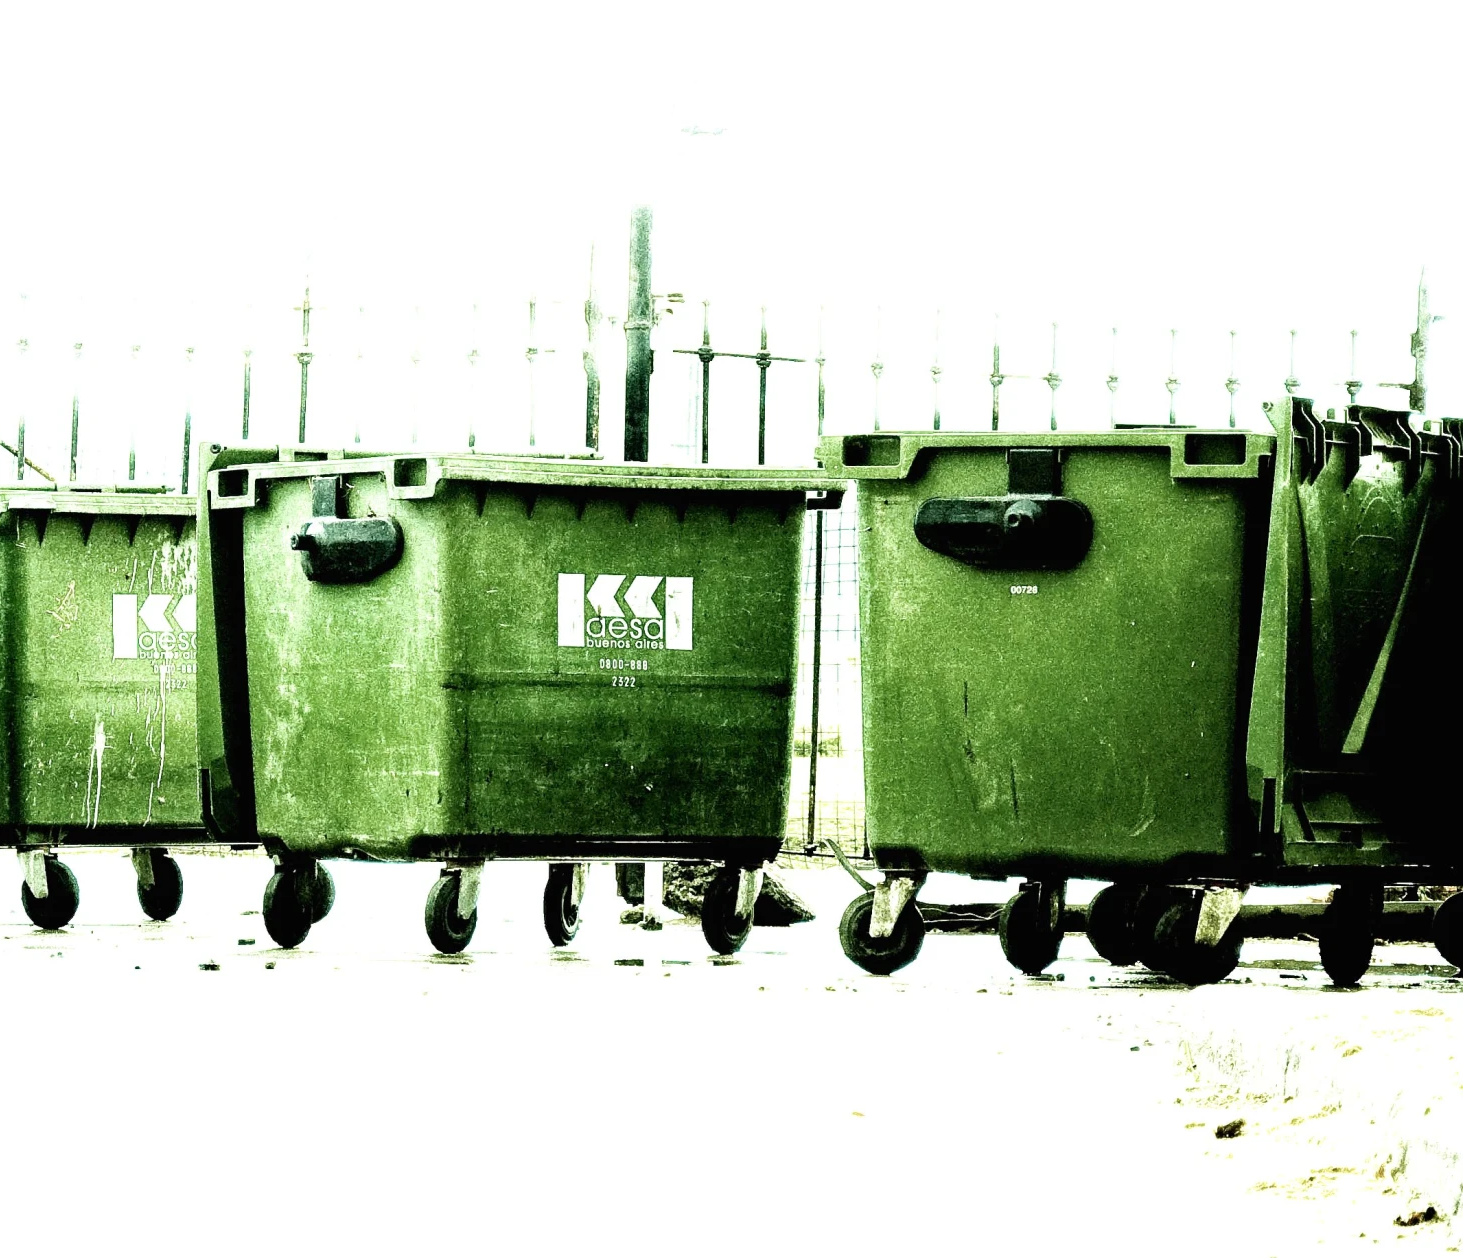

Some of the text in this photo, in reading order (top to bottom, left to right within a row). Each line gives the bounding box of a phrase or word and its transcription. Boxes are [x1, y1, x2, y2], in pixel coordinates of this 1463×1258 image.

[586, 617, 663, 640] aesa
[587, 636, 664, 650] buenos aires
[153, 663, 197, 674] 000-888
[599, 659, 648, 671] 0800-888
[612, 675, 636, 688] 2322
